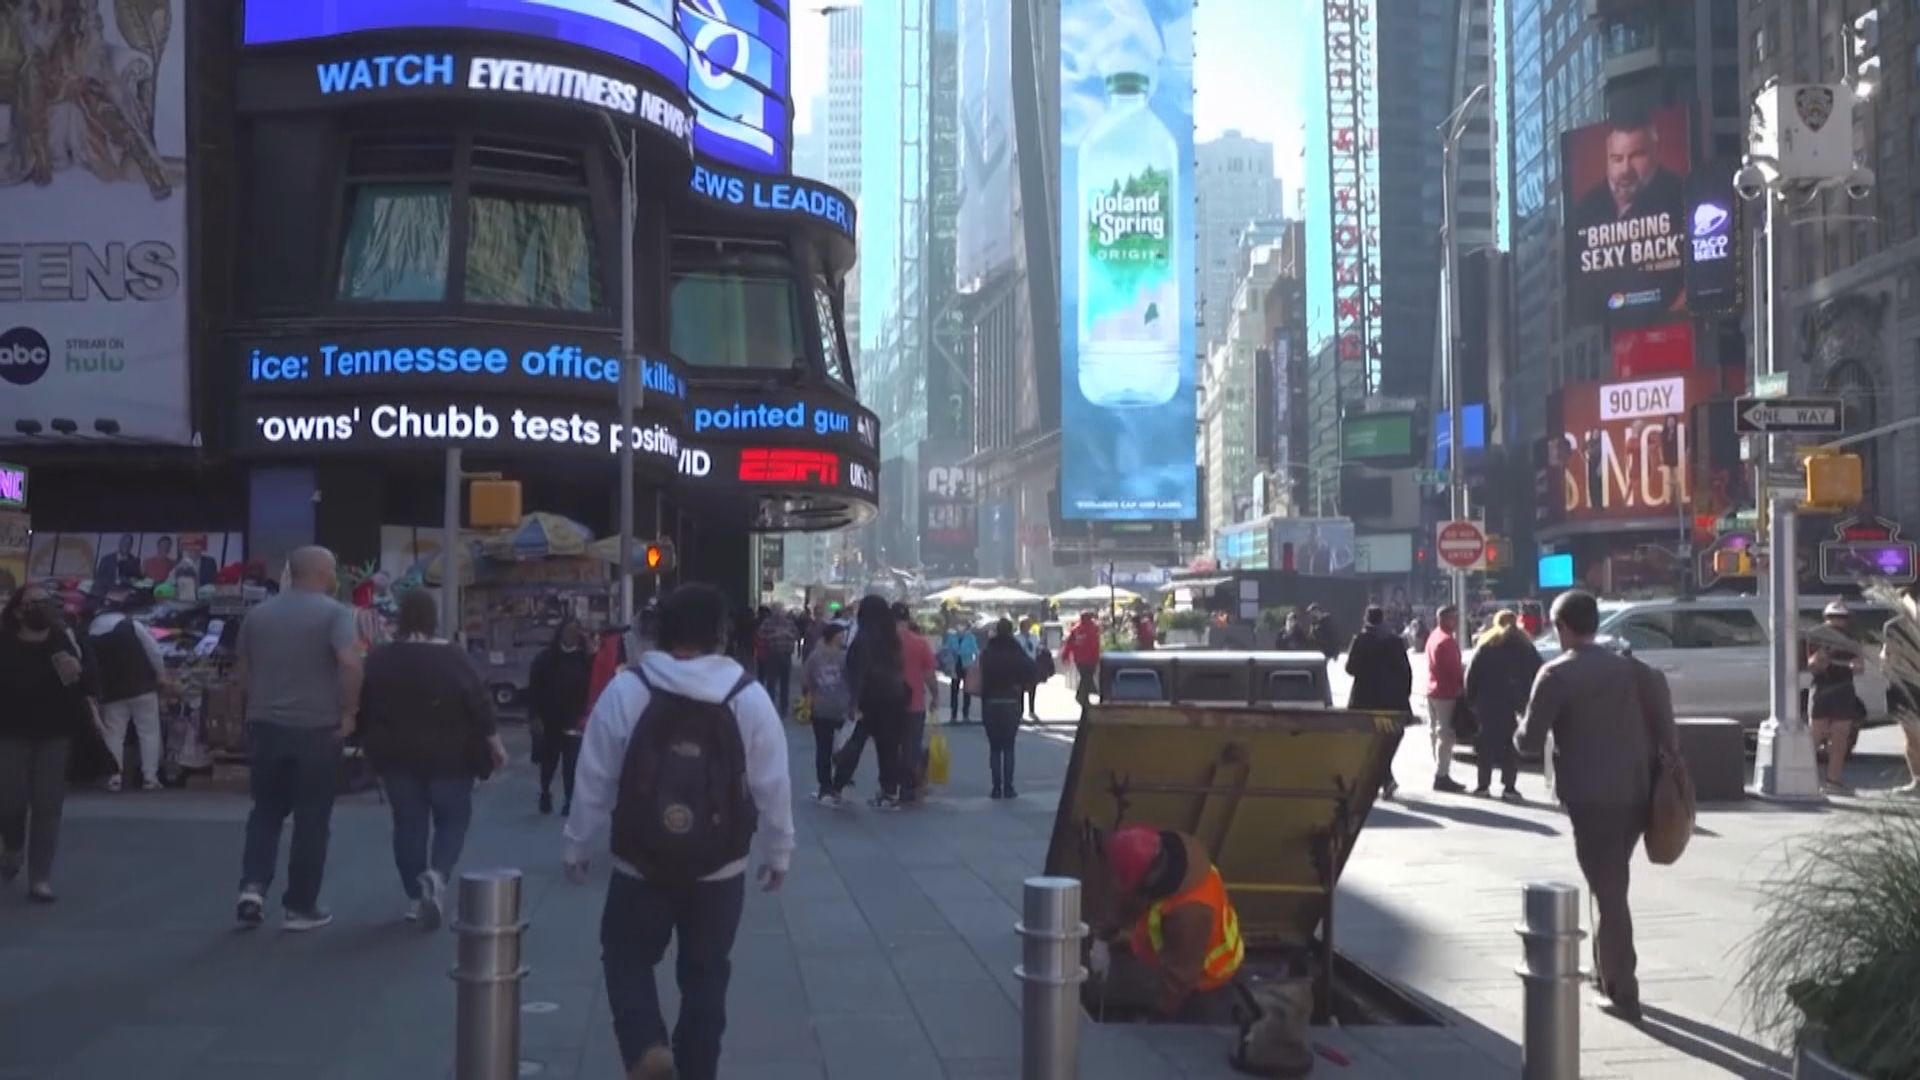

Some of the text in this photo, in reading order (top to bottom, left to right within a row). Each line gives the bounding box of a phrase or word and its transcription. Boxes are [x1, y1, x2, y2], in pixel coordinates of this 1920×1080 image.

[317, 54, 685, 138] WATCH EYEWITNESS NEWS
[691, 165, 744, 203] EWS
[1091, 191, 1159, 224] Poland
[1099, 213, 1164, 246] Spring
[1692, 235, 1728, 250] TACO
[1581, 246, 1626, 272] SEXY
[1694, 247, 1728, 261] BELL
[0, 342, 47, 365] abc
[65, 338, 124, 350] STREAM ON
[66, 351, 124, 373] hulu
[251, 349, 309, 380] ice:
[320, 345, 508, 376] Tennessee
[641, 356, 676, 394] kills
[1609, 385, 1674, 414] 90 DAY
[1752, 408, 1826, 422] ONE WAY
[257, 407, 360, 440] owns'
[371, 405, 499, 438] Chubb
[511, 409, 601, 445] tests
[695, 401, 805, 432] pointed
[814, 408, 849, 434] gun
[739, 449, 840, 485] ESPN
